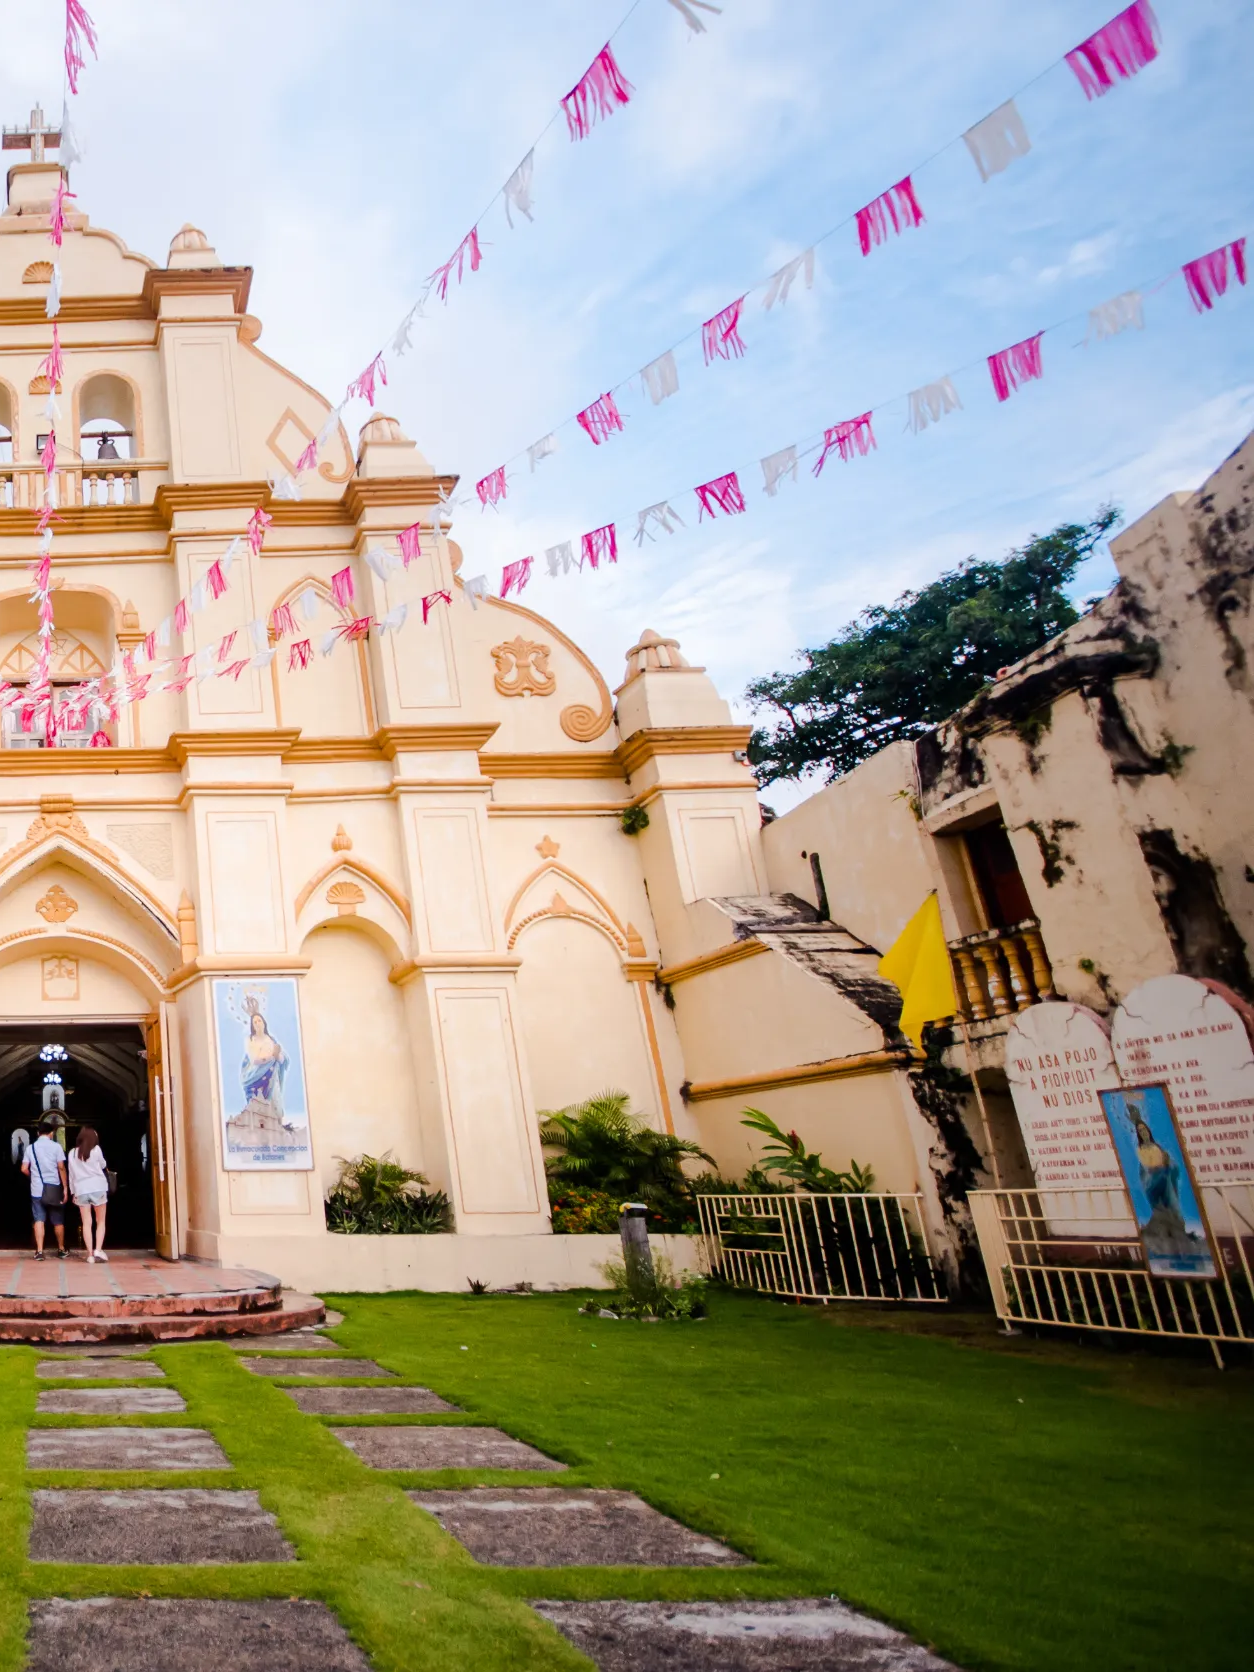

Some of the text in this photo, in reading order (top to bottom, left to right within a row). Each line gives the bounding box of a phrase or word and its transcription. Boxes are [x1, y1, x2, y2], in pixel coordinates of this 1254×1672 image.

[1017, 1047, 1097, 1072] NU ASA POJO
[1030, 1077, 1037, 1091] A
[1042, 1089, 1092, 1108] NU DIOS
